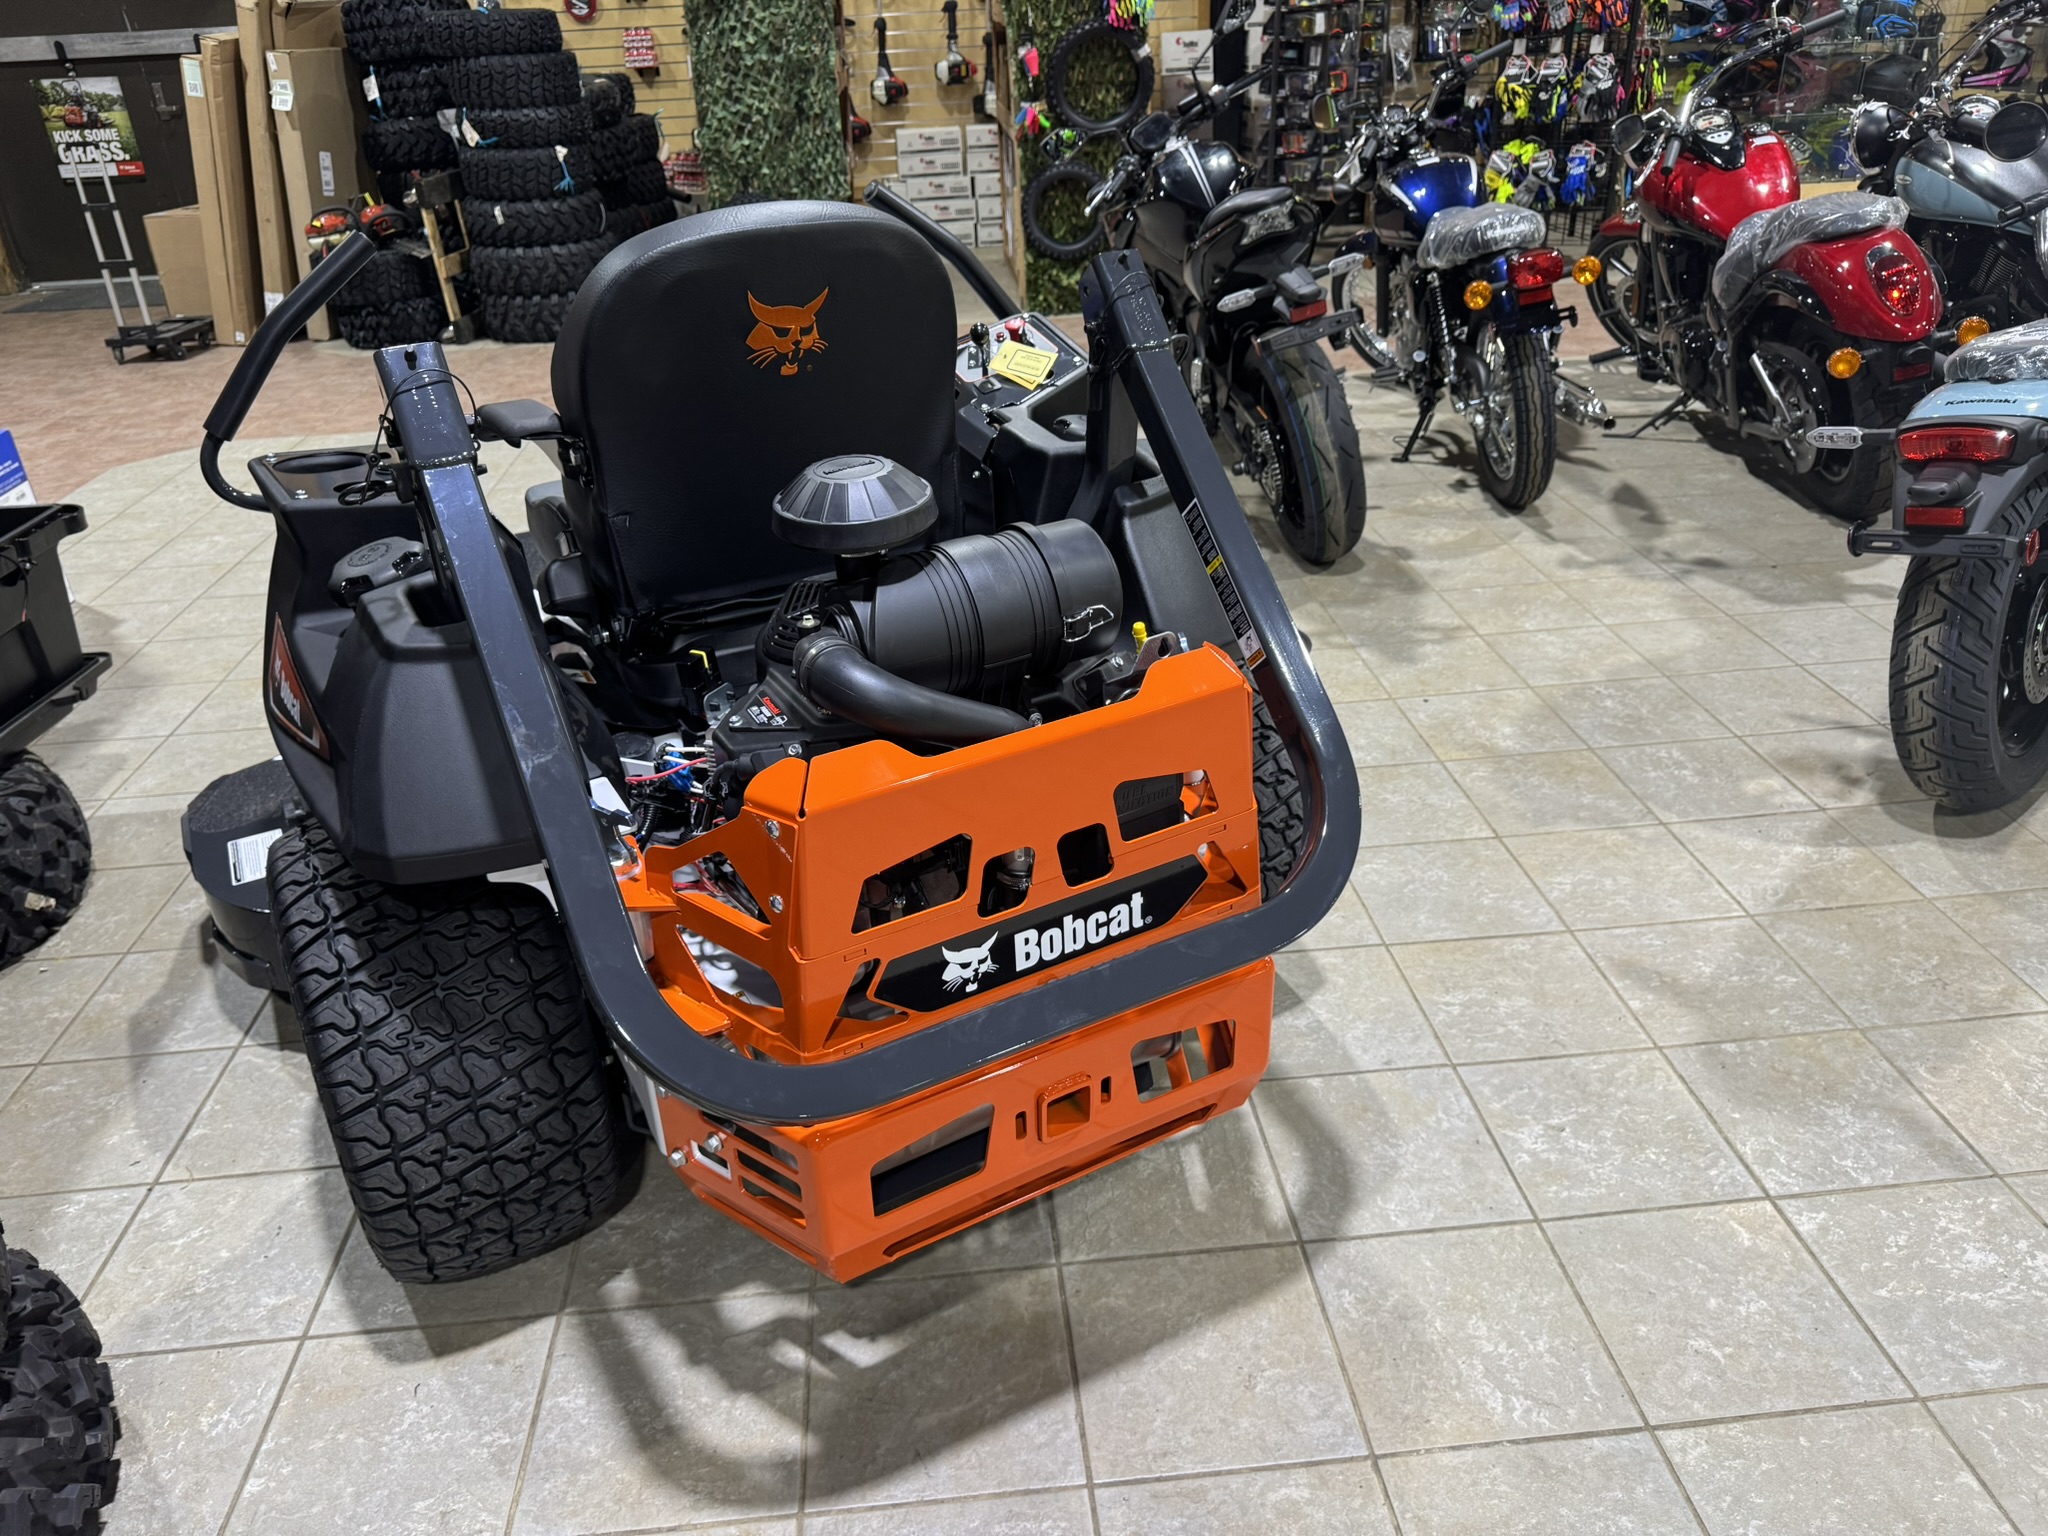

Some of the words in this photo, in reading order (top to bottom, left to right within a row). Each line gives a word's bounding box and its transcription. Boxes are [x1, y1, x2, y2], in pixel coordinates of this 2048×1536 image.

[52, 129, 83, 143] KICK
[84, 128, 120, 142] SOME
[1944, 398, 2019, 406] Kawasaki
[1013, 891, 1145, 972] Bobcat
